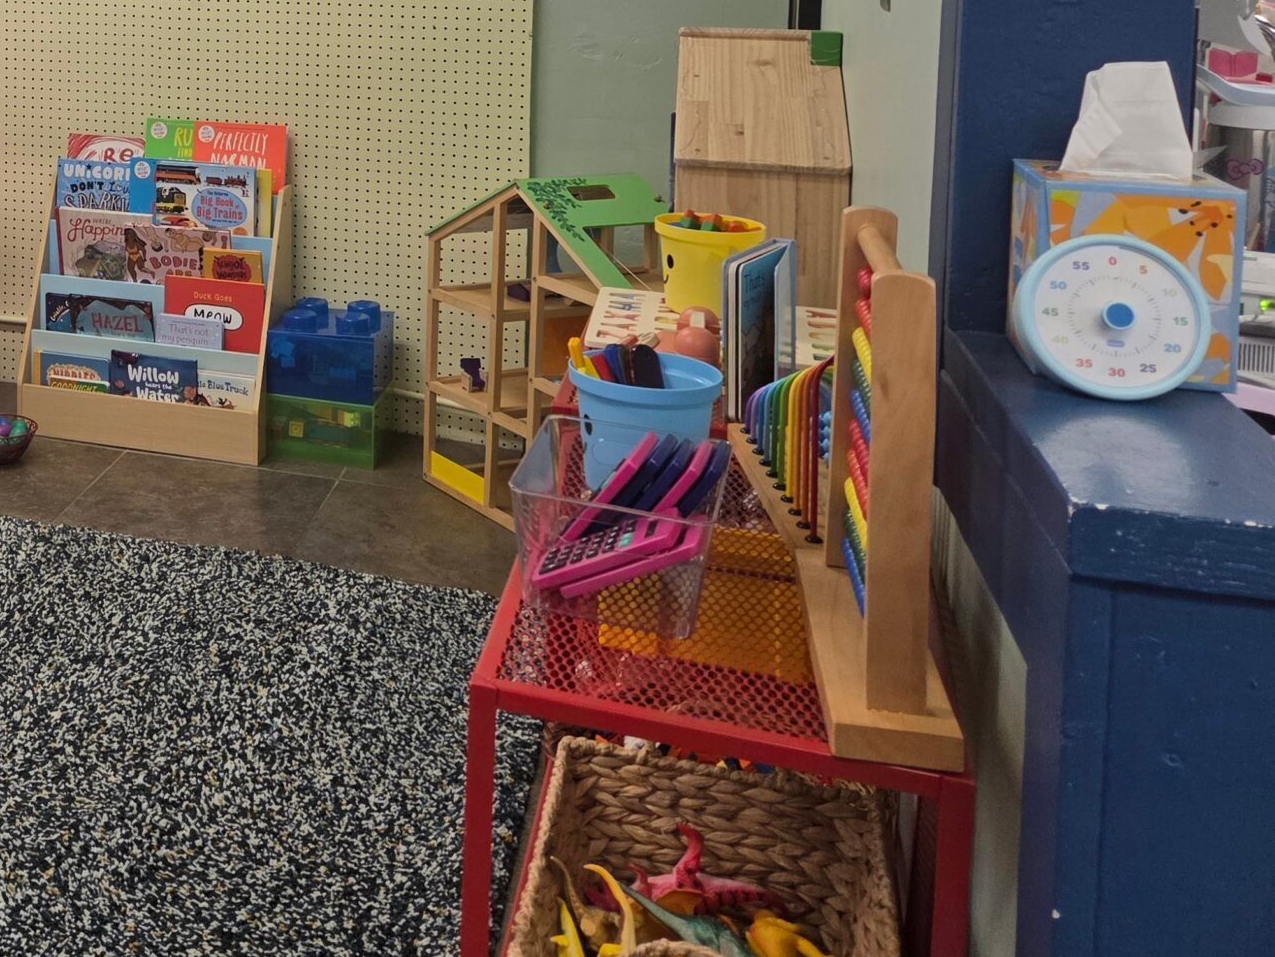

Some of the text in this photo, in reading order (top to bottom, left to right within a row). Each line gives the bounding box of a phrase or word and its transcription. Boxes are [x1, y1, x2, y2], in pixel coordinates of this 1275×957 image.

[213, 131, 268, 155] PERFECTLY
[70, 181, 104, 194] DON'T
[200, 195, 213, 207] Big
[215, 196, 234, 207] Book
[196, 206, 244, 221] Big Trains
[1072, 260, 1090, 271] 55
[1108, 256, 1118, 267] 0
[1139, 265, 1149, 275] 5
[1049, 280, 1068, 290] 50
[193, 291, 233, 303] Duck Goes
[1041, 307, 1059, 317] 45
[91, 312, 143, 333] HAZEL
[1173, 316, 1189, 327] 15
[170, 323, 209, 336] That's not
[162, 334, 175, 343] my
[1051, 335, 1070, 345] 40
[1163, 343, 1182, 354] 20
[1075, 358, 1093, 369] 35
[1139, 363, 1157, 374] 25
[1108, 367, 1125, 378] 30
[162, 382, 173, 390] the
[207, 380, 249, 396] Blue Truck
[136, 386, 179, 403] Water
